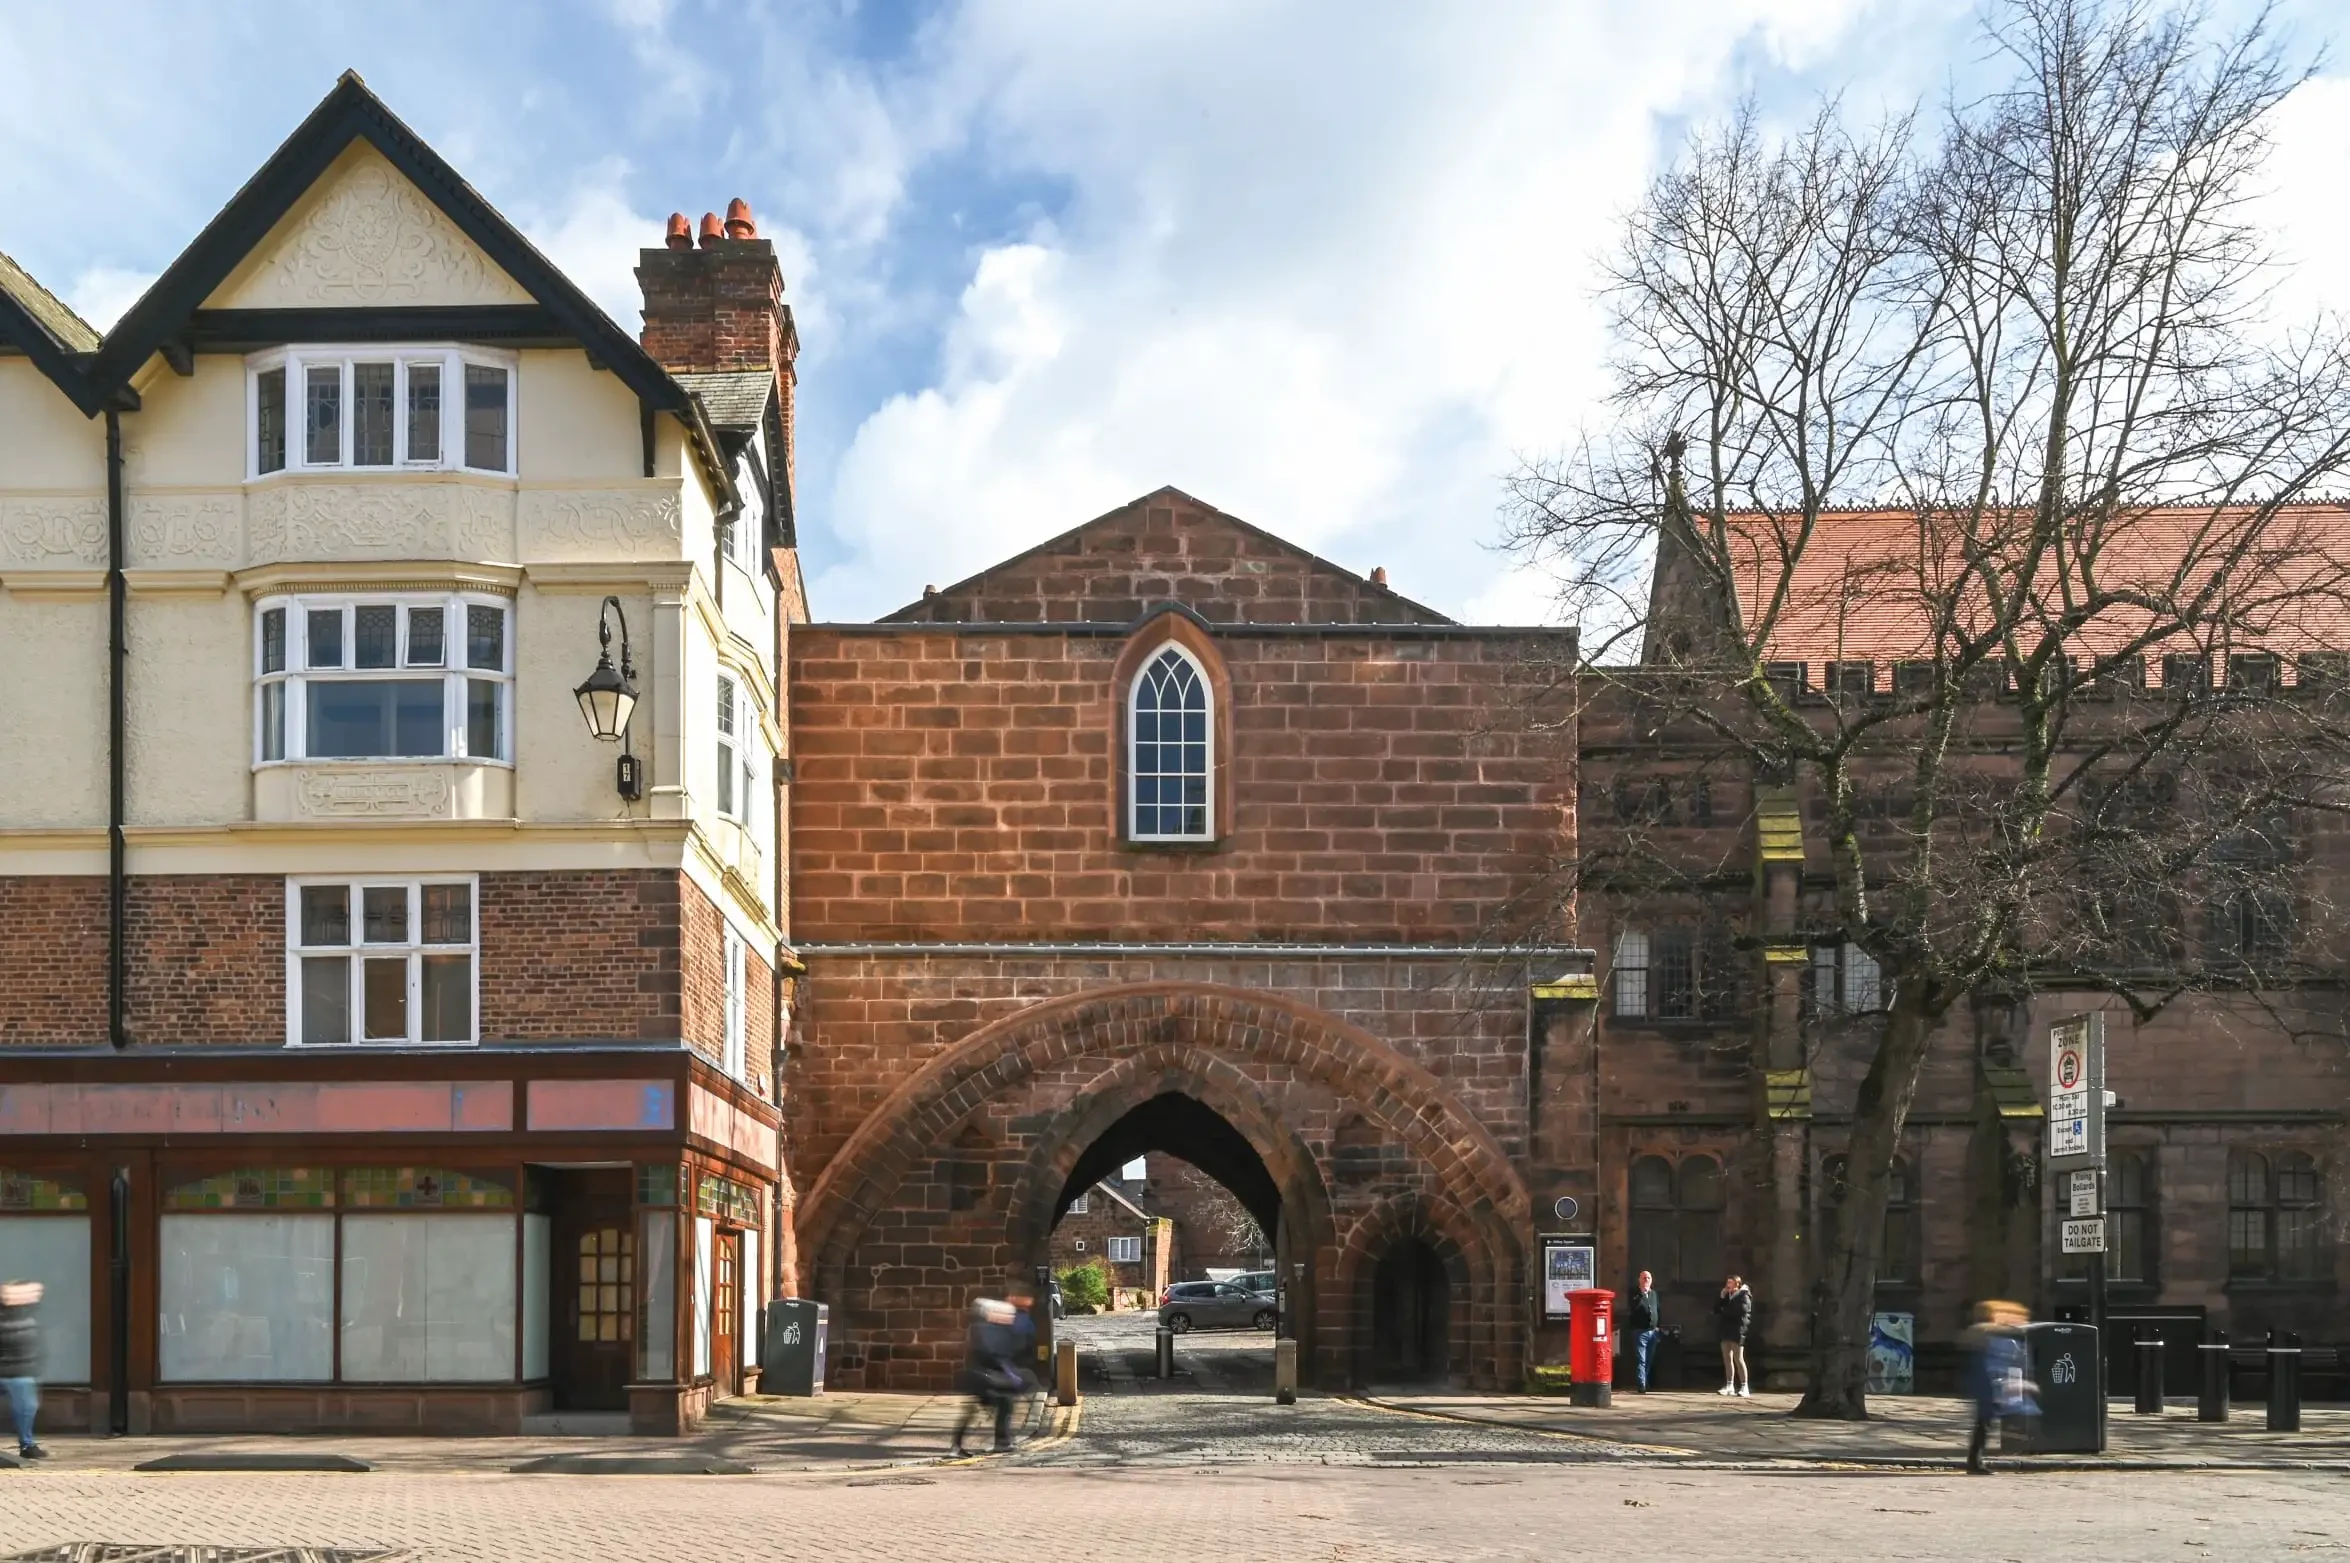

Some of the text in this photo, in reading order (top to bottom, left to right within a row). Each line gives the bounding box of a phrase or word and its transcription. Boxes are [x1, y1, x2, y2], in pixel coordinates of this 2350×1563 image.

[2058, 1034, 2080, 1047] ZONE
[2075, 1172, 2092, 1181] Rising
[2072, 1182, 2095, 1191] Bollards
[2068, 1224, 2098, 1235] DO NOT
[2064, 1237, 2101, 1248] TAILGATE
